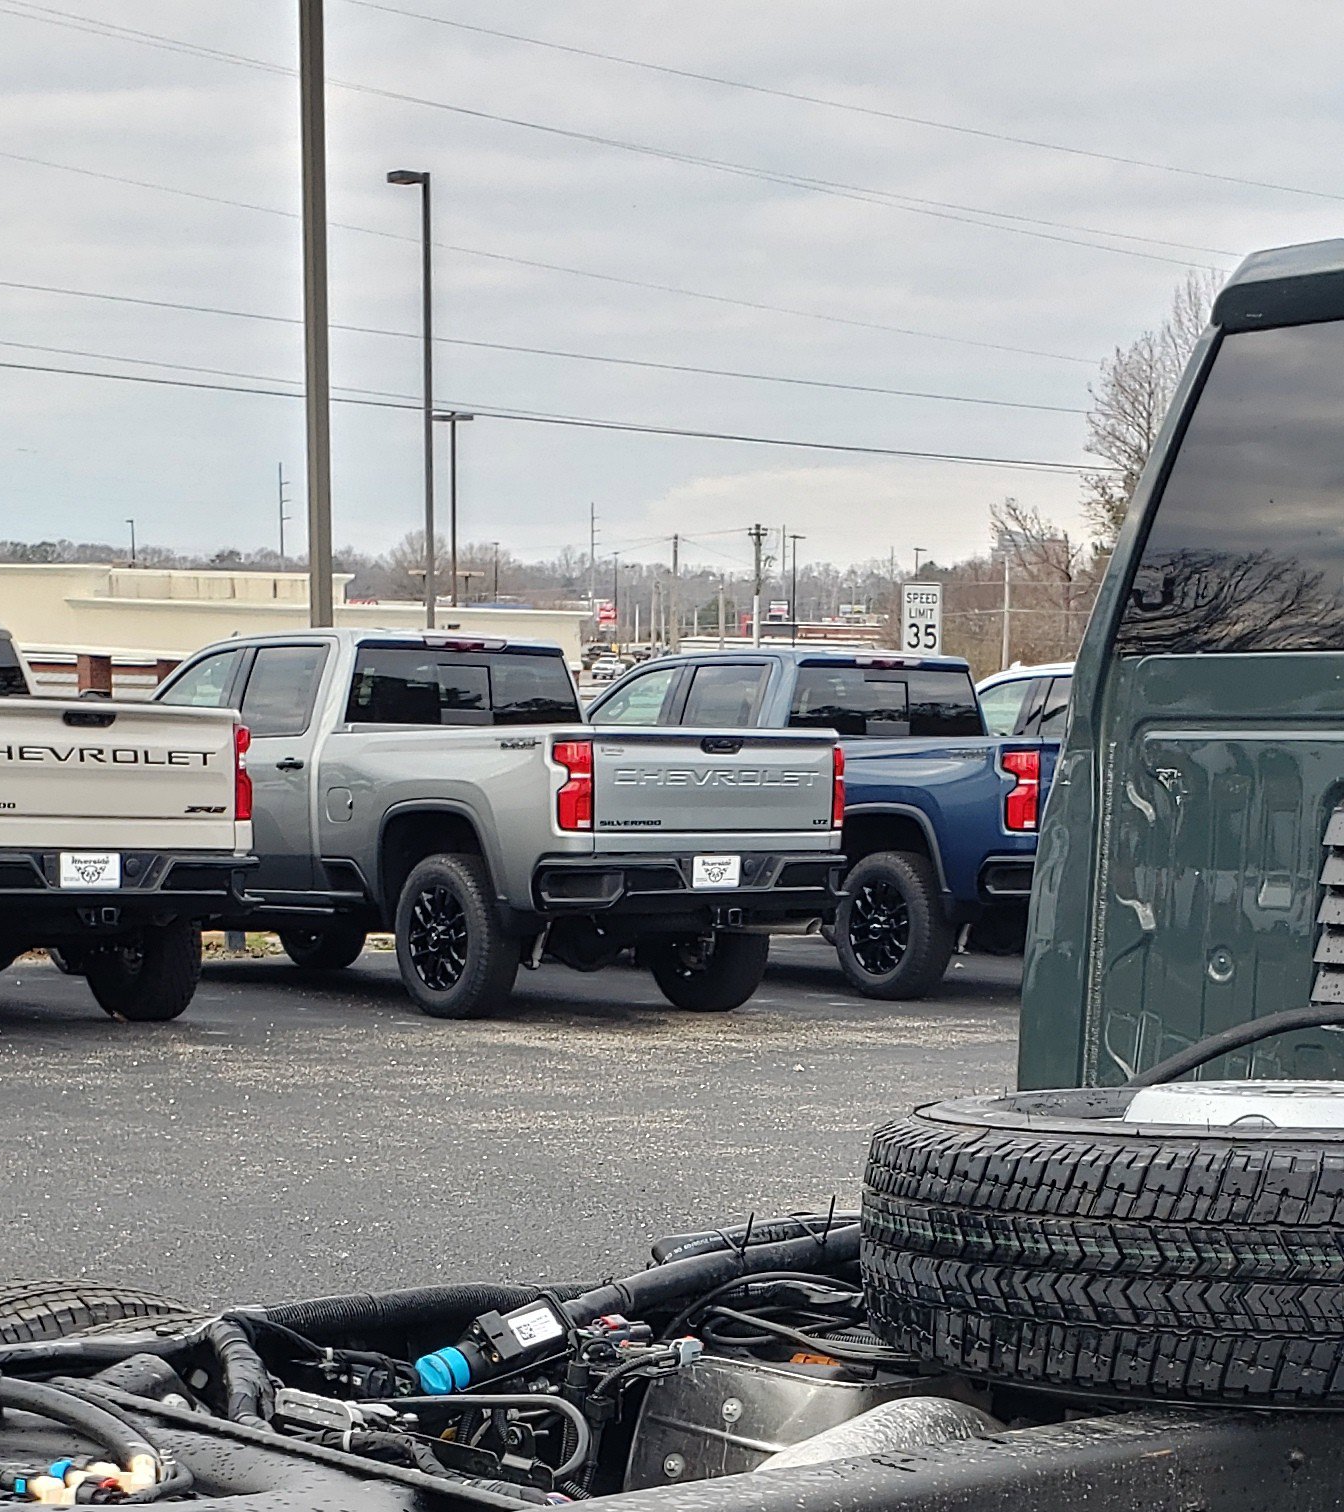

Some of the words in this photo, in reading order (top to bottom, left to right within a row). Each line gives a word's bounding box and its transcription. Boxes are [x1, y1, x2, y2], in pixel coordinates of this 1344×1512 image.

[906, 592, 938, 605] SPEED
[908, 607, 934, 619] LIMIT
[906, 622, 937, 650] 35
[613, 768, 821, 787] CHEVROLET
[183, 805, 227, 814] ZR2
[599, 819, 662, 827] SILVERADO
